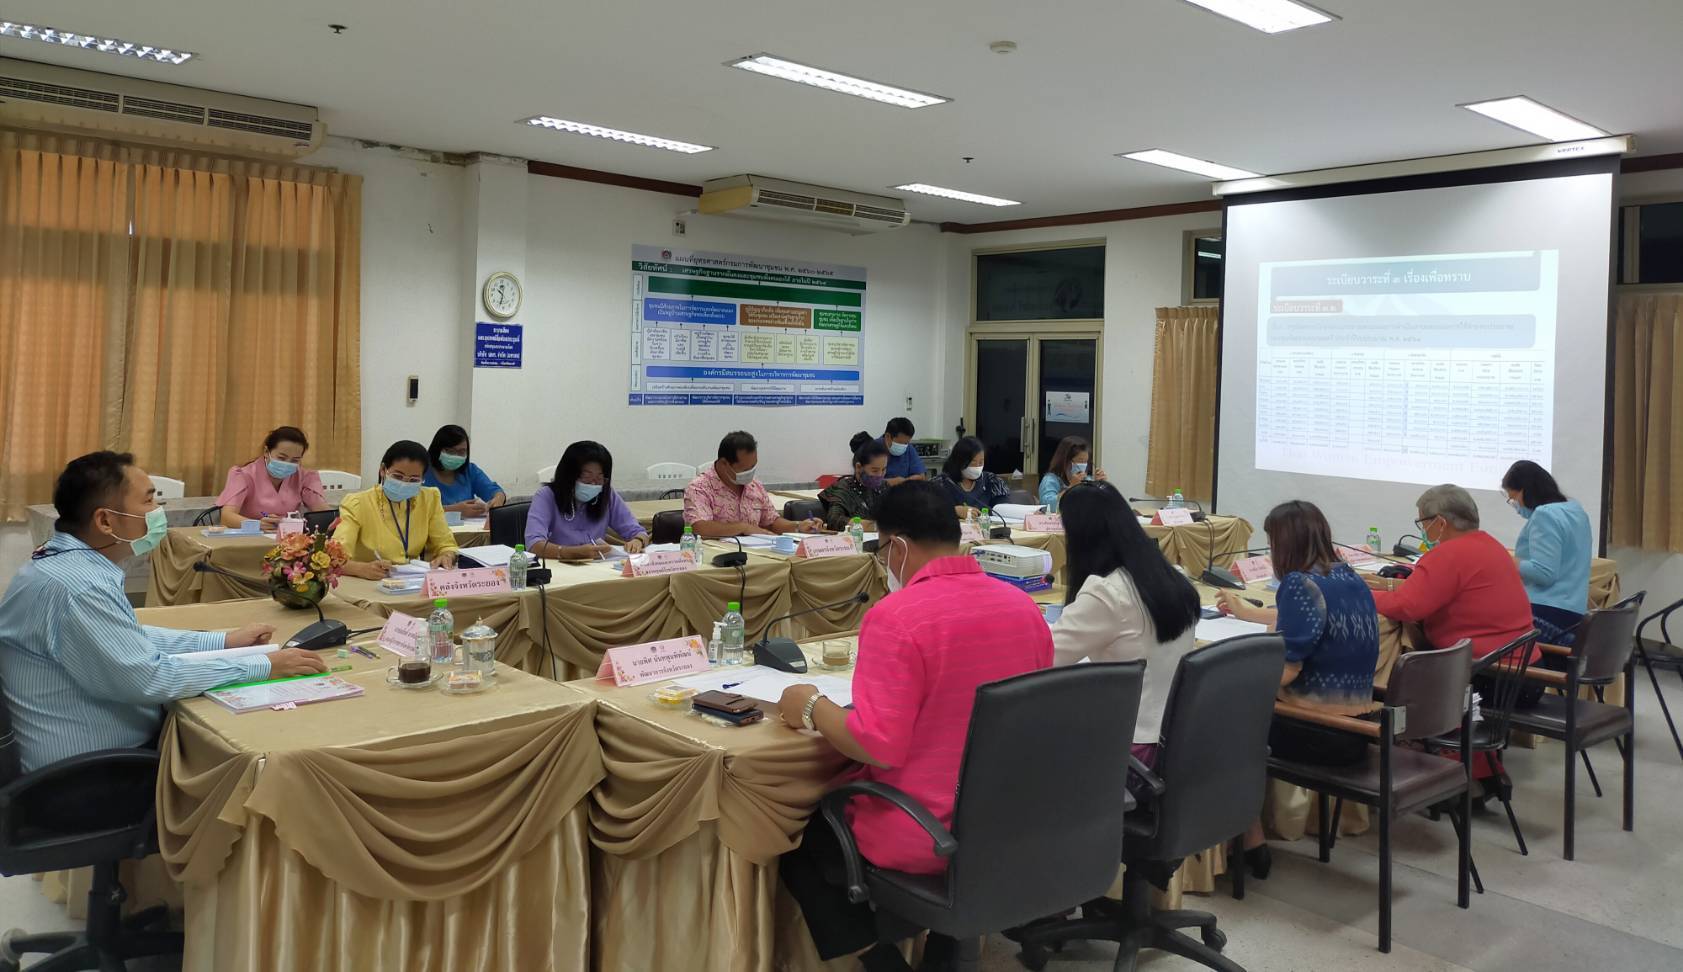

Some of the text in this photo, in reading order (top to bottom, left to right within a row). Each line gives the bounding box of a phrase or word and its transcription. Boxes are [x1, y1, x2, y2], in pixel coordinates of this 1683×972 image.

[1404, 268, 1471, 285] เรื่องเพื่อทราบ
[439, 579, 501, 591] คลังจังหวัดระยอง
